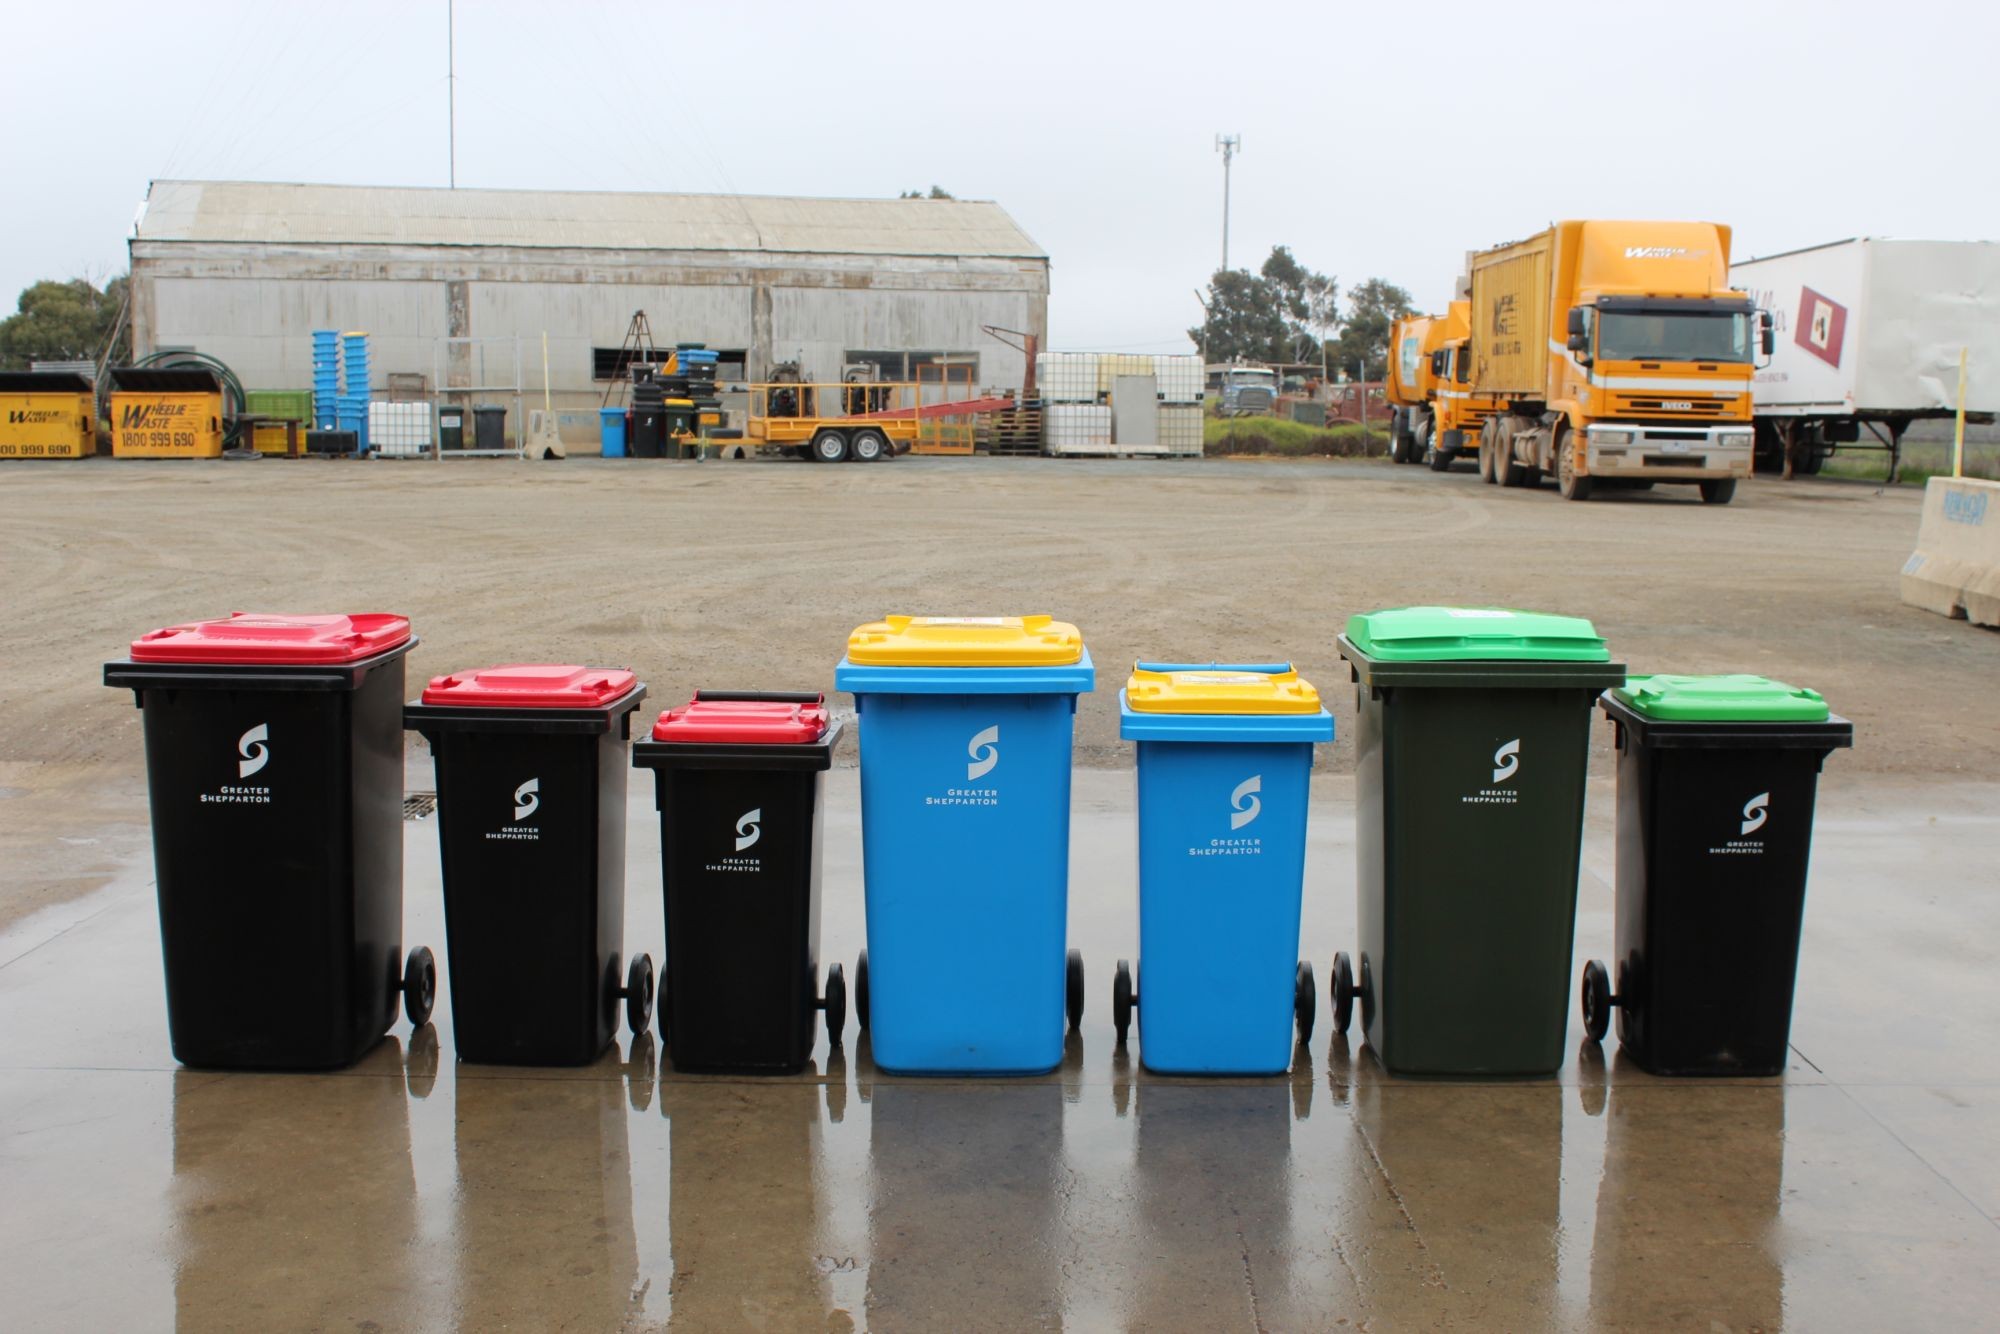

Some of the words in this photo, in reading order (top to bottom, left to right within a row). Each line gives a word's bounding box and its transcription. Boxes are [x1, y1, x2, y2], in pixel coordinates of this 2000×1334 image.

[122, 432, 146, 447] 1800
[150, 432, 170, 447] 999
[173, 432, 194, 447] 690
[20, 445, 44, 455] 999
[48, 445, 71, 455] 690
[220, 786, 270, 794] GREATER
[947, 789, 998, 797] GREATER
[200, 794, 271, 803] SHEPPARTON
[925, 797, 998, 805] SHEPPARTON
[1210, 839, 1261, 847] GREATER
[1189, 847, 1261, 856] SHEPPARTON
[705, 864, 761, 873] SHEPPARTON
